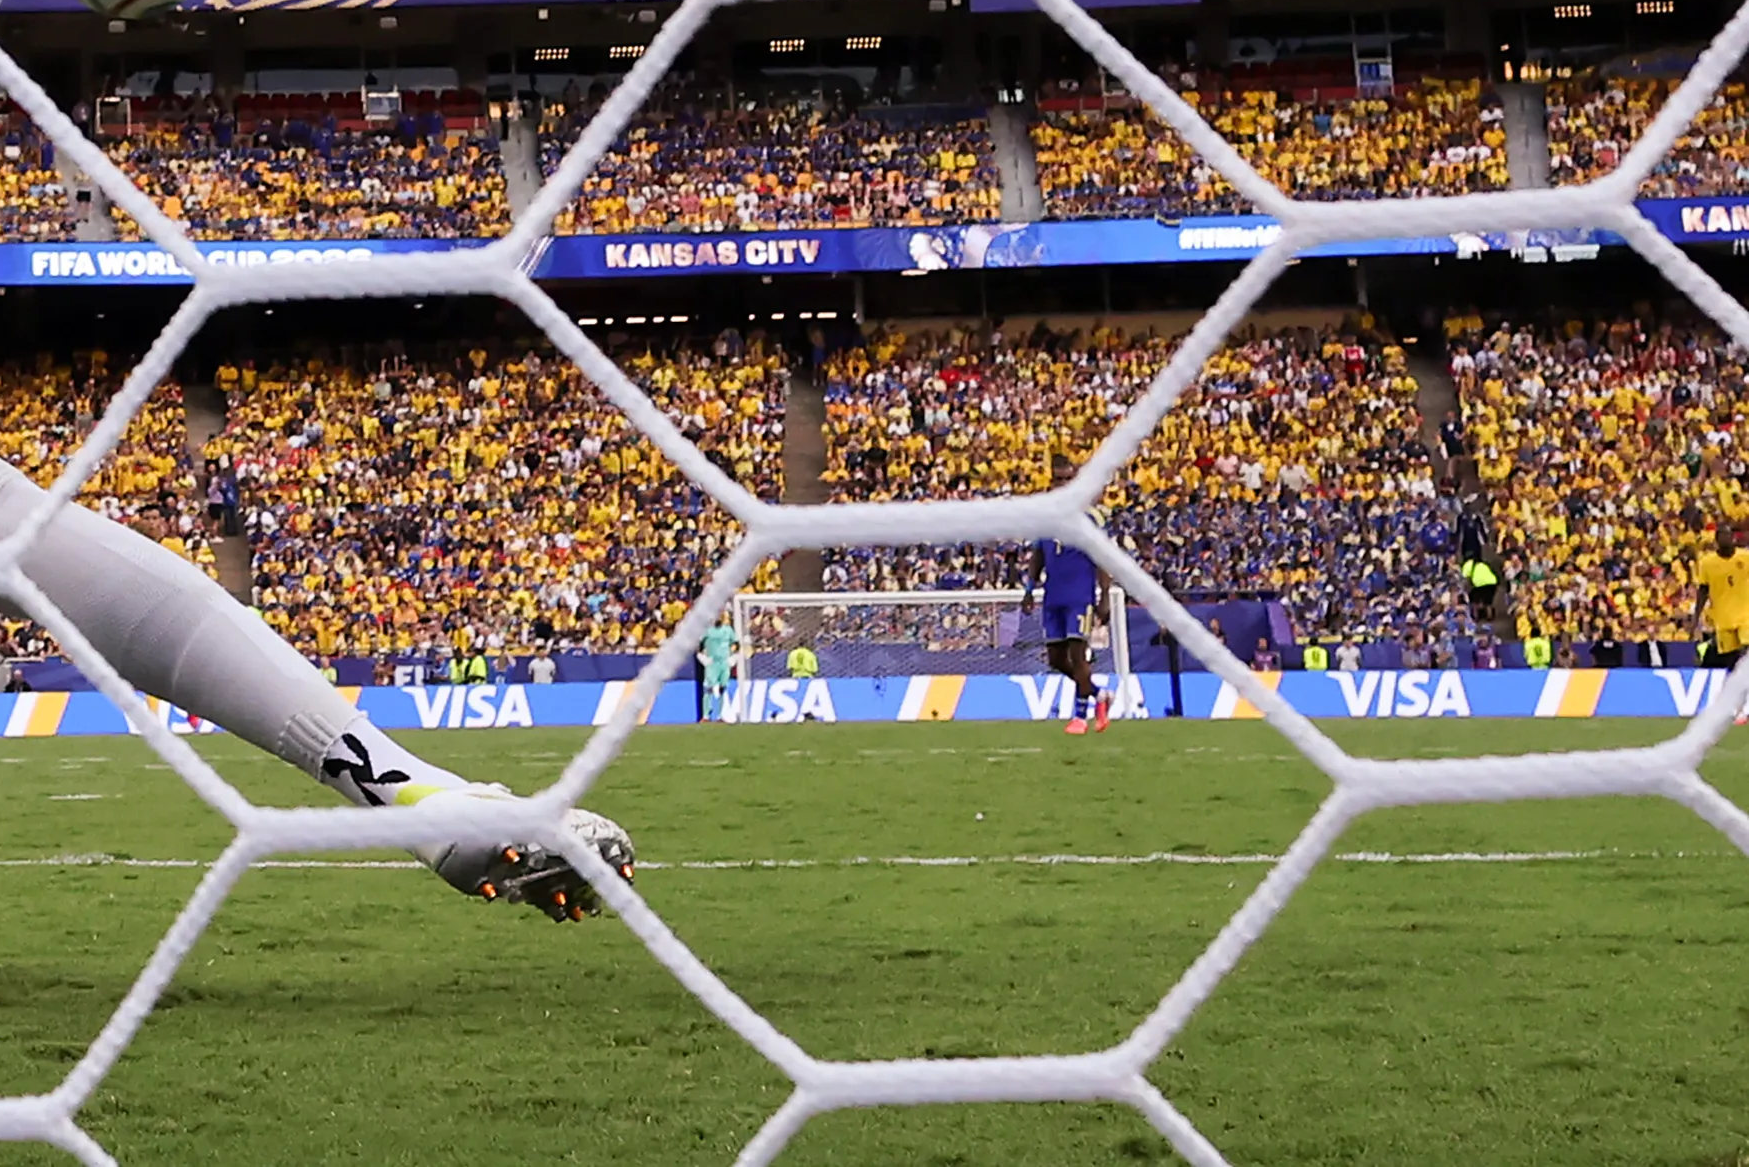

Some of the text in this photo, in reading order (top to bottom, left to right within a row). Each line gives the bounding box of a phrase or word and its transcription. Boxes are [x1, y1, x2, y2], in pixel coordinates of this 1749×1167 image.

[32, 251, 96, 276] FIFA
[97, 251, 197, 276] WORL
[605, 239, 820, 268] KANSAS CITY
[402, 685, 533, 728] VISA
[713, 679, 837, 723] VISA
[1325, 670, 1471, 718] VISA
